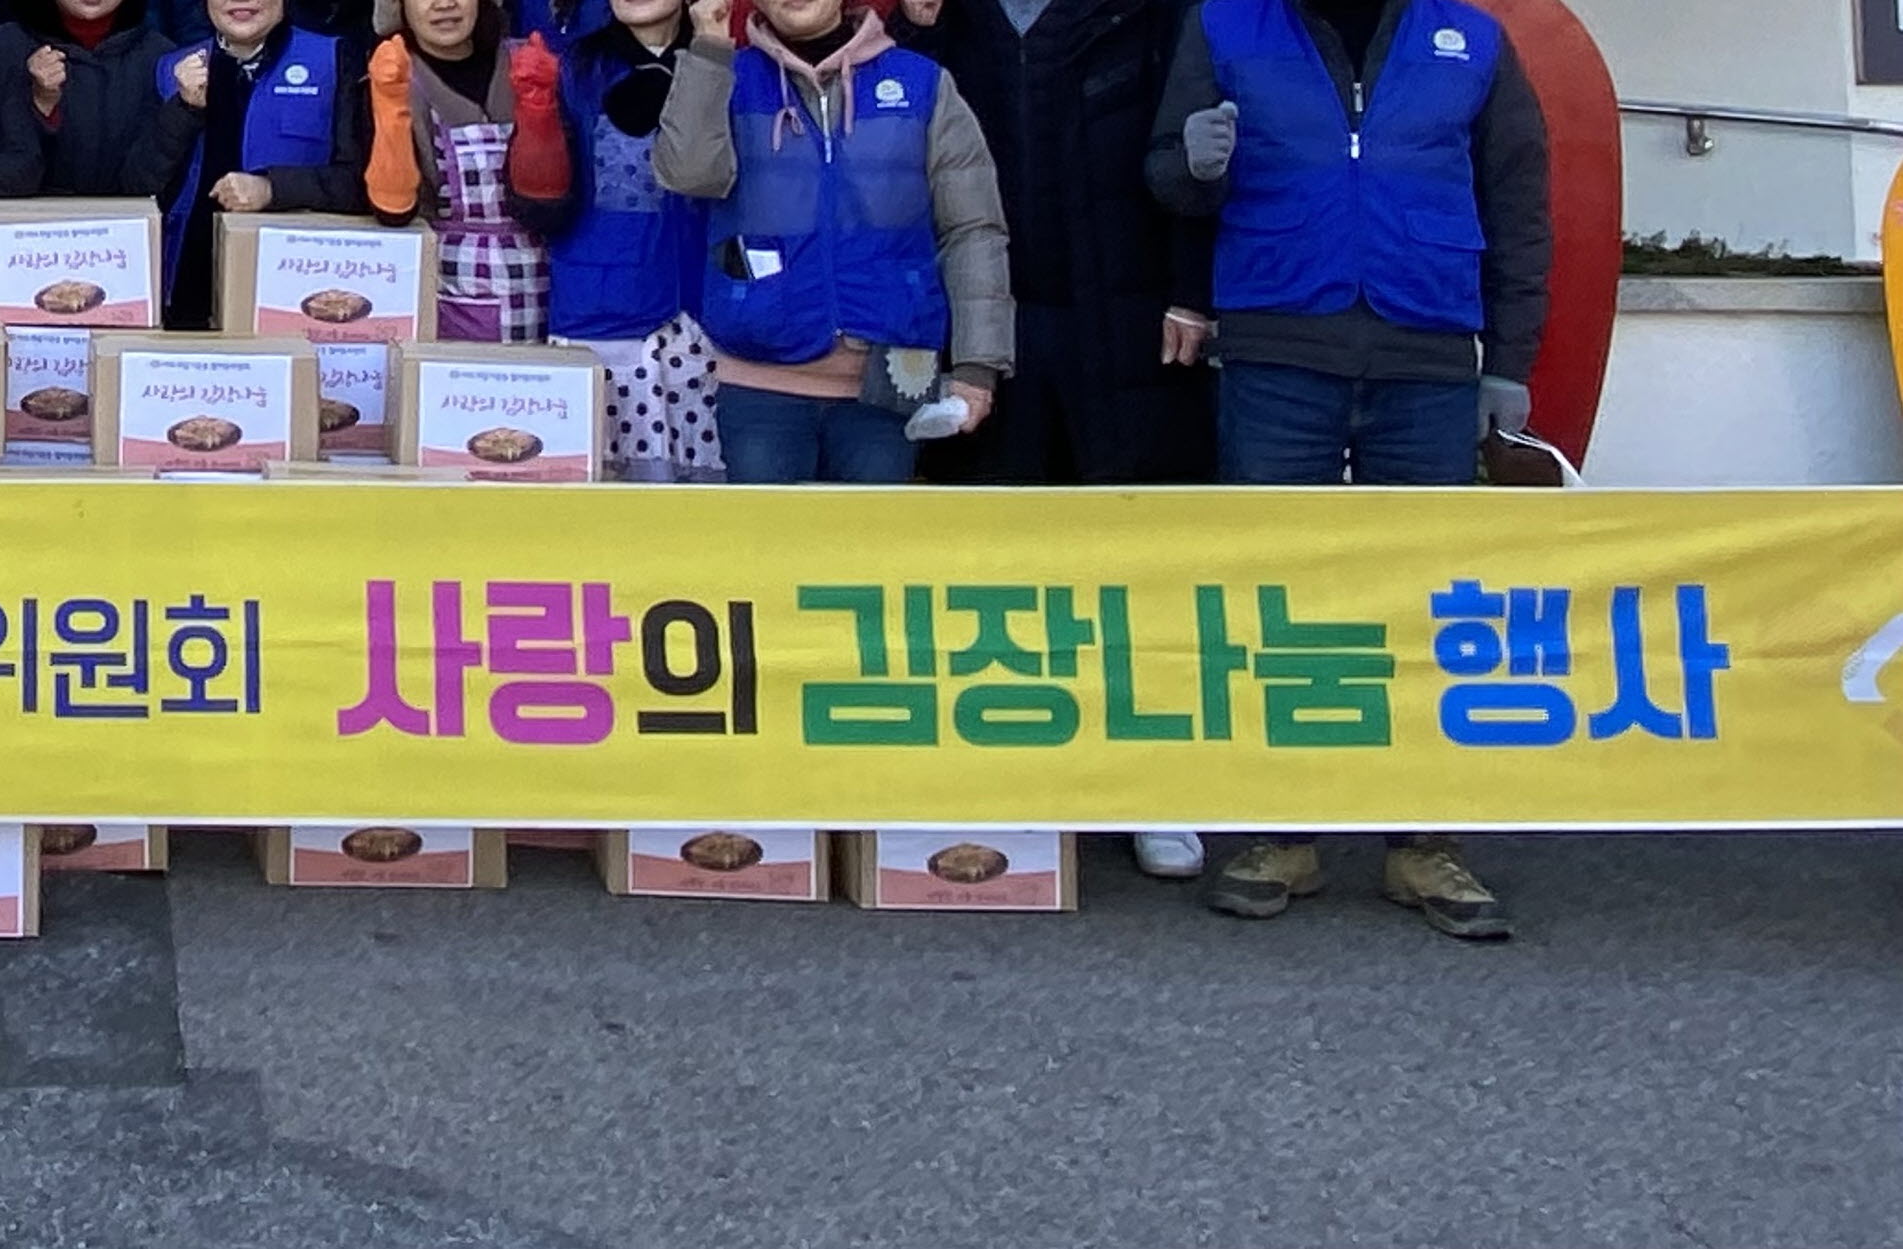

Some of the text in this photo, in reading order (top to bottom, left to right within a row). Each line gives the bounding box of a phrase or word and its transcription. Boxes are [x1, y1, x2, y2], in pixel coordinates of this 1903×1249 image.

[337, 580, 760, 745] 사랑의
[797, 584, 1396, 749] 김장나눔
[1430, 580, 1731, 746] 행사
